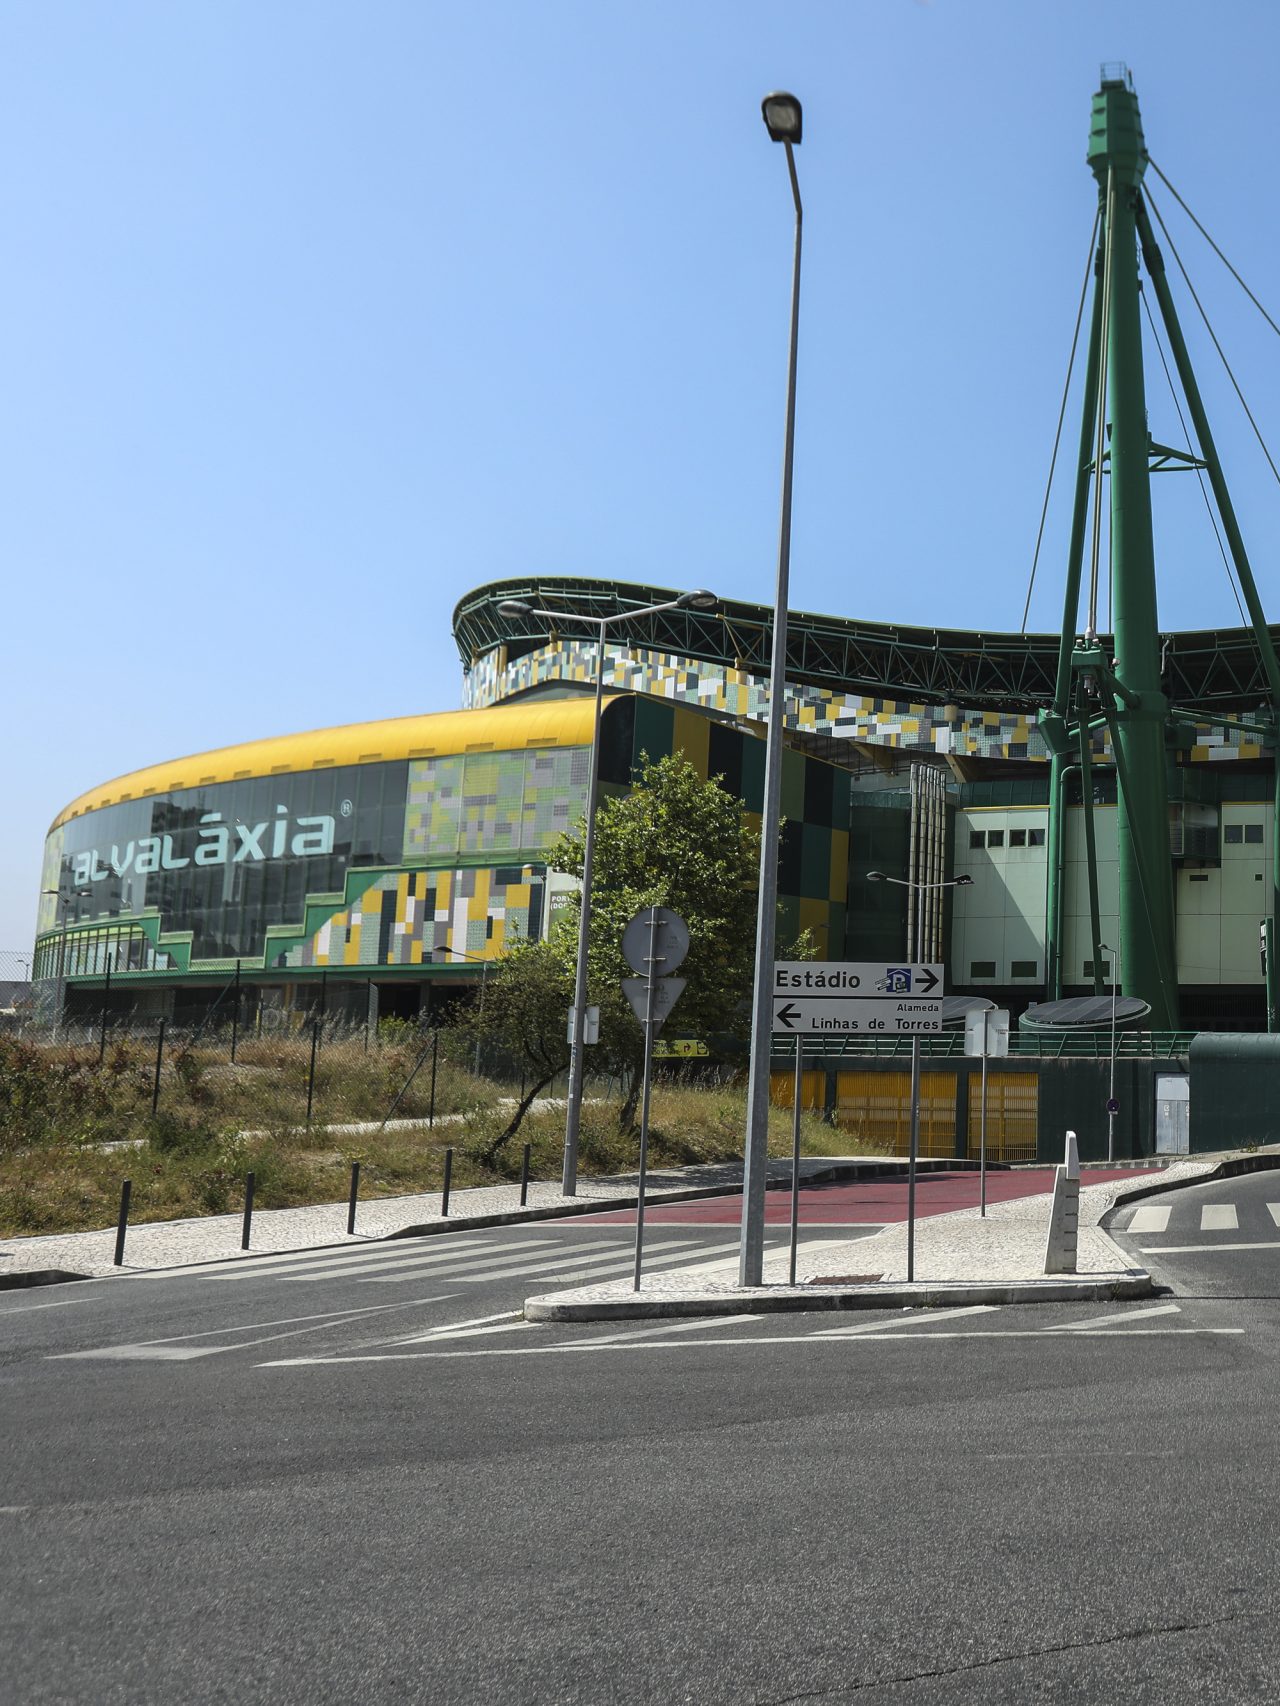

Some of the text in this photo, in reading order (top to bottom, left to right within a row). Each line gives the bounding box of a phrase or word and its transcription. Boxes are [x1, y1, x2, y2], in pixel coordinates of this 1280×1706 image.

[776, 969, 861, 989] Estádio
[897, 1003, 939, 1012] Alameda
[812, 1017, 939, 1029] Linhas de Torres
